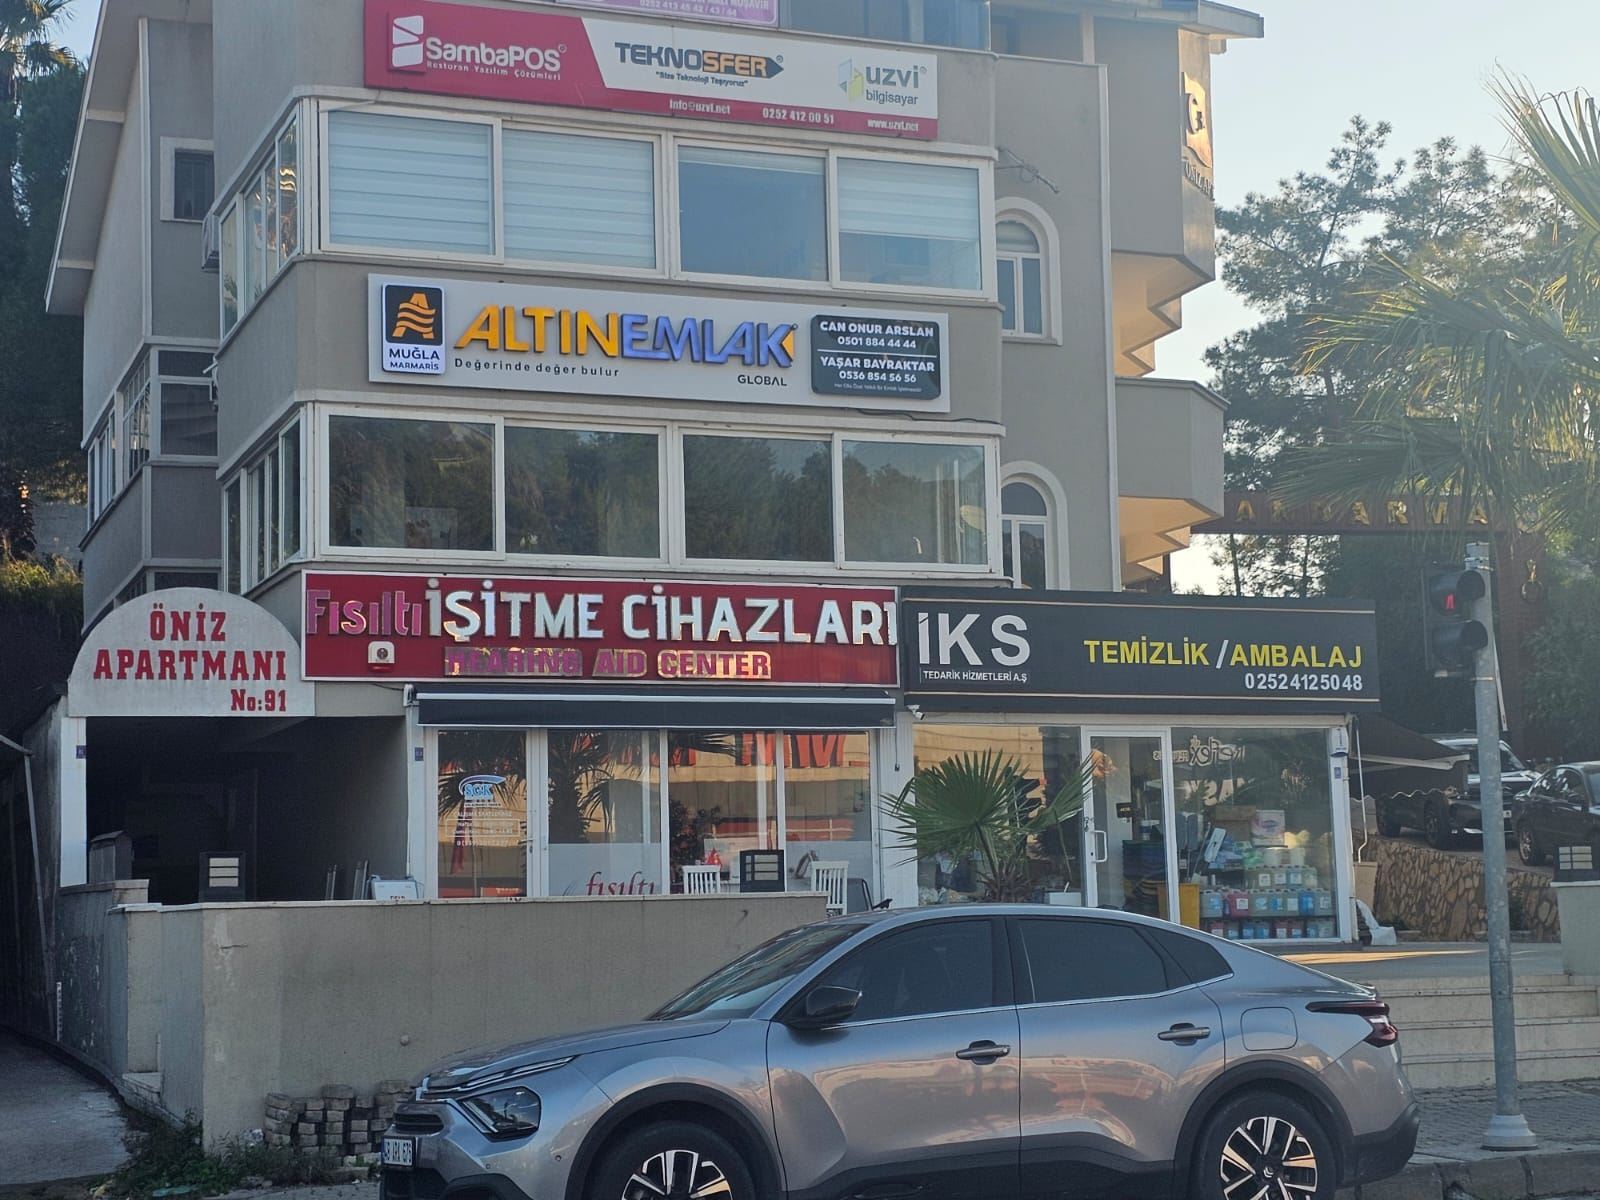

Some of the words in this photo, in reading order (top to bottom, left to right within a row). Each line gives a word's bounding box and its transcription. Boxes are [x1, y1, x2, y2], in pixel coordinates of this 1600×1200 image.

[426, 37, 561, 72] SambaPOS
[614, 41, 767, 77] TEKNOSFER
[427, 61, 469, 72] Restoran
[474, 66, 508, 76] Yazılım
[514, 70, 561, 80] Çözümleri
[865, 64, 919, 89] uzvi
[866, 89, 919, 106] bilgisayar
[762, 107, 787, 121] 0252
[789, 109, 807, 122] 412
[808, 110, 821, 123] 00
[823, 112, 834, 124] 51
[820, 321, 846, 332] CAN
[848, 323, 882, 334] ONUR
[885, 325, 934, 337] ARSLAN
[837, 336, 863, 346] 0501
[865, 337, 885, 347] 884
[887, 339, 900, 348] 44
[902, 339, 916, 349] 44
[388, 346, 440, 361] MUĞLA
[390, 361, 439, 371] MARMARİS
[454, 358, 530, 371] Değerinde
[536, 362, 576, 375] değer
[581, 365, 619, 377] bulur
[820, 356, 860, 369] YAŞAR
[863, 358, 935, 372] BAYRAKTAR
[737, 374, 787, 386] GLOBAL
[839, 371, 865, 380] 0536
[867, 372, 886, 381] 854
[889, 373, 902, 382] 56
[904, 374, 917, 383] 56
[306, 589, 422, 637] Fısıltı
[425, 577, 604, 642] İŞİTME
[622, 583, 898, 646] CİHAZLARI
[150, 603, 226, 642] ÖNİZ
[918, 612, 1031, 667] İKS
[1084, 635, 1209, 665] TEMİZLİK
[93, 649, 286, 680] APARTMANI
[447, 649, 582, 675] HEARING
[595, 650, 646, 676] AID
[659, 651, 771, 678] CENTER
[923, 669, 961, 680] TEDARİK
[962, 669, 1012, 681] HİZMETLERİ
[1245, 672, 1363, 691] 02524125048
[230, 688, 286, 711] No:91
